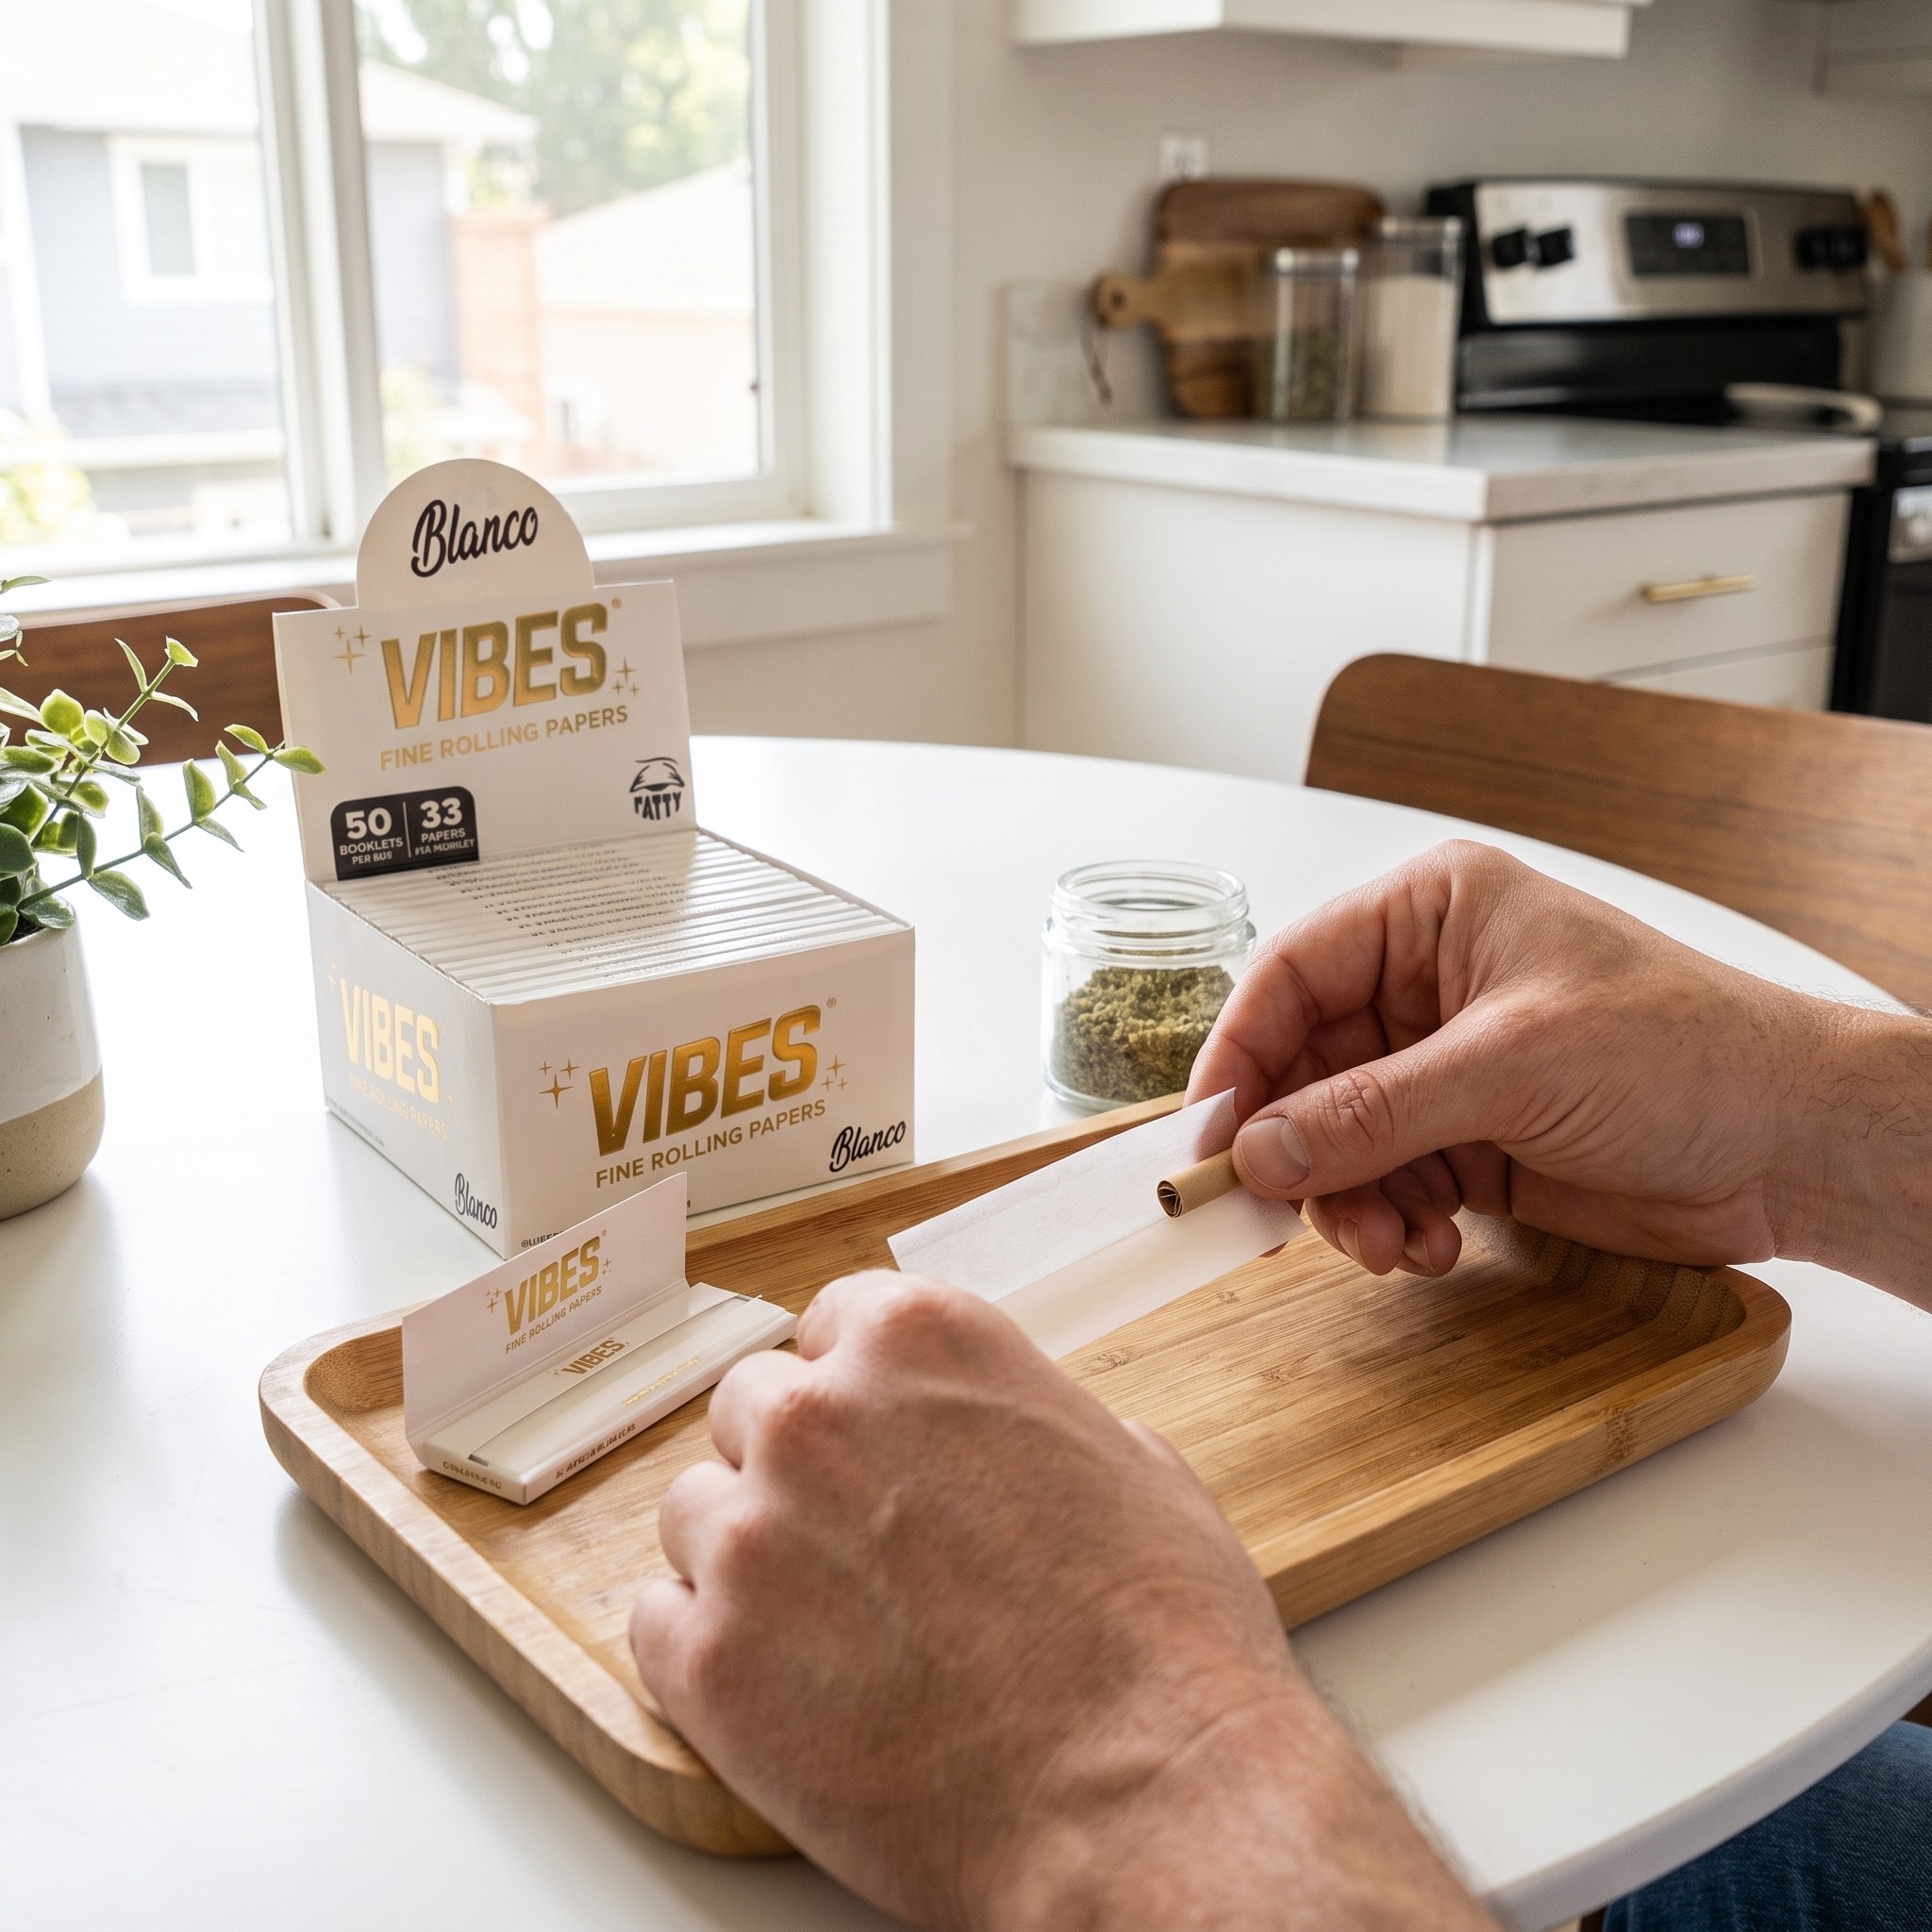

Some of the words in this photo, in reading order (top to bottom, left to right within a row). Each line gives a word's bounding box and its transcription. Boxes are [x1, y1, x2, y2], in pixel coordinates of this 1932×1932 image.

[411, 499, 539, 577] Blanco
[380, 602, 608, 730] VIBES
[380, 742, 433, 771] FINE
[440, 723, 539, 759] ROLLING
[545, 705, 628, 739] PAPERS
[345, 807, 392, 840] 50
[420, 797, 463, 828] 33
[421, 827, 466, 843] PAPERS
[340, 837, 404, 856] BOOKLETS
[352, 854, 371, 865] PER
[340, 977, 441, 1105] VIBES
[589, 1004, 821, 1158] VIBES
[595, 1158, 643, 1189] FINE
[651, 1126, 742, 1172] ROLLING
[749, 1099, 825, 1140] PAPERS
[829, 1121, 907, 1173] Blanco
[455, 1173, 498, 1229] Blanco
[504, 1235, 601, 1336] VIBES
[506, 1335, 527, 1355] FINE
[529, 1309, 567, 1340] ROLLING
[568, 1285, 602, 1313] PAPERS
[560, 1339, 626, 1375] VIBES
